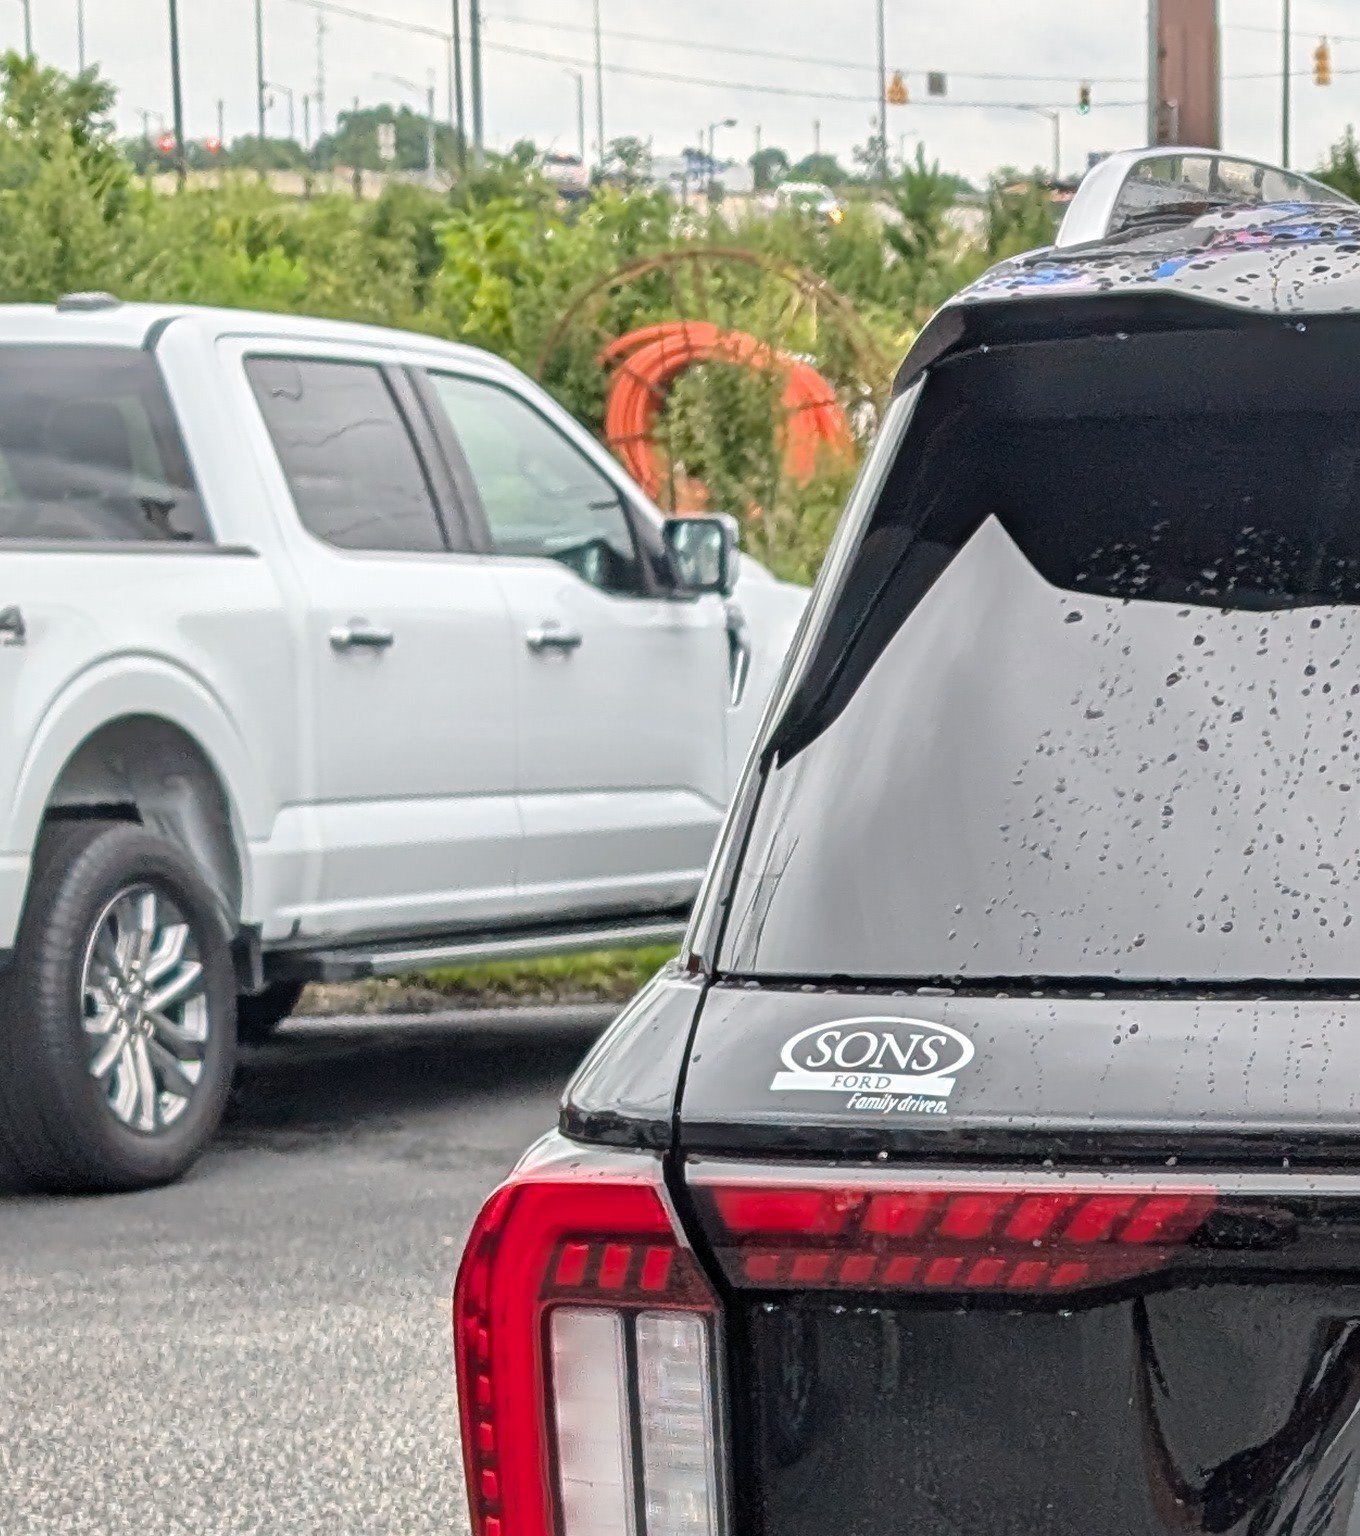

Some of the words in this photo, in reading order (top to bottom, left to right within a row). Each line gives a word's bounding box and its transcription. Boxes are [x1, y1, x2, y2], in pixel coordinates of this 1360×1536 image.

[806, 1030, 947, 1071] SONS
[831, 1074, 892, 1090] FORD
[846, 1091, 899, 1114] Family
[897, 1095, 948, 1115] driven.
